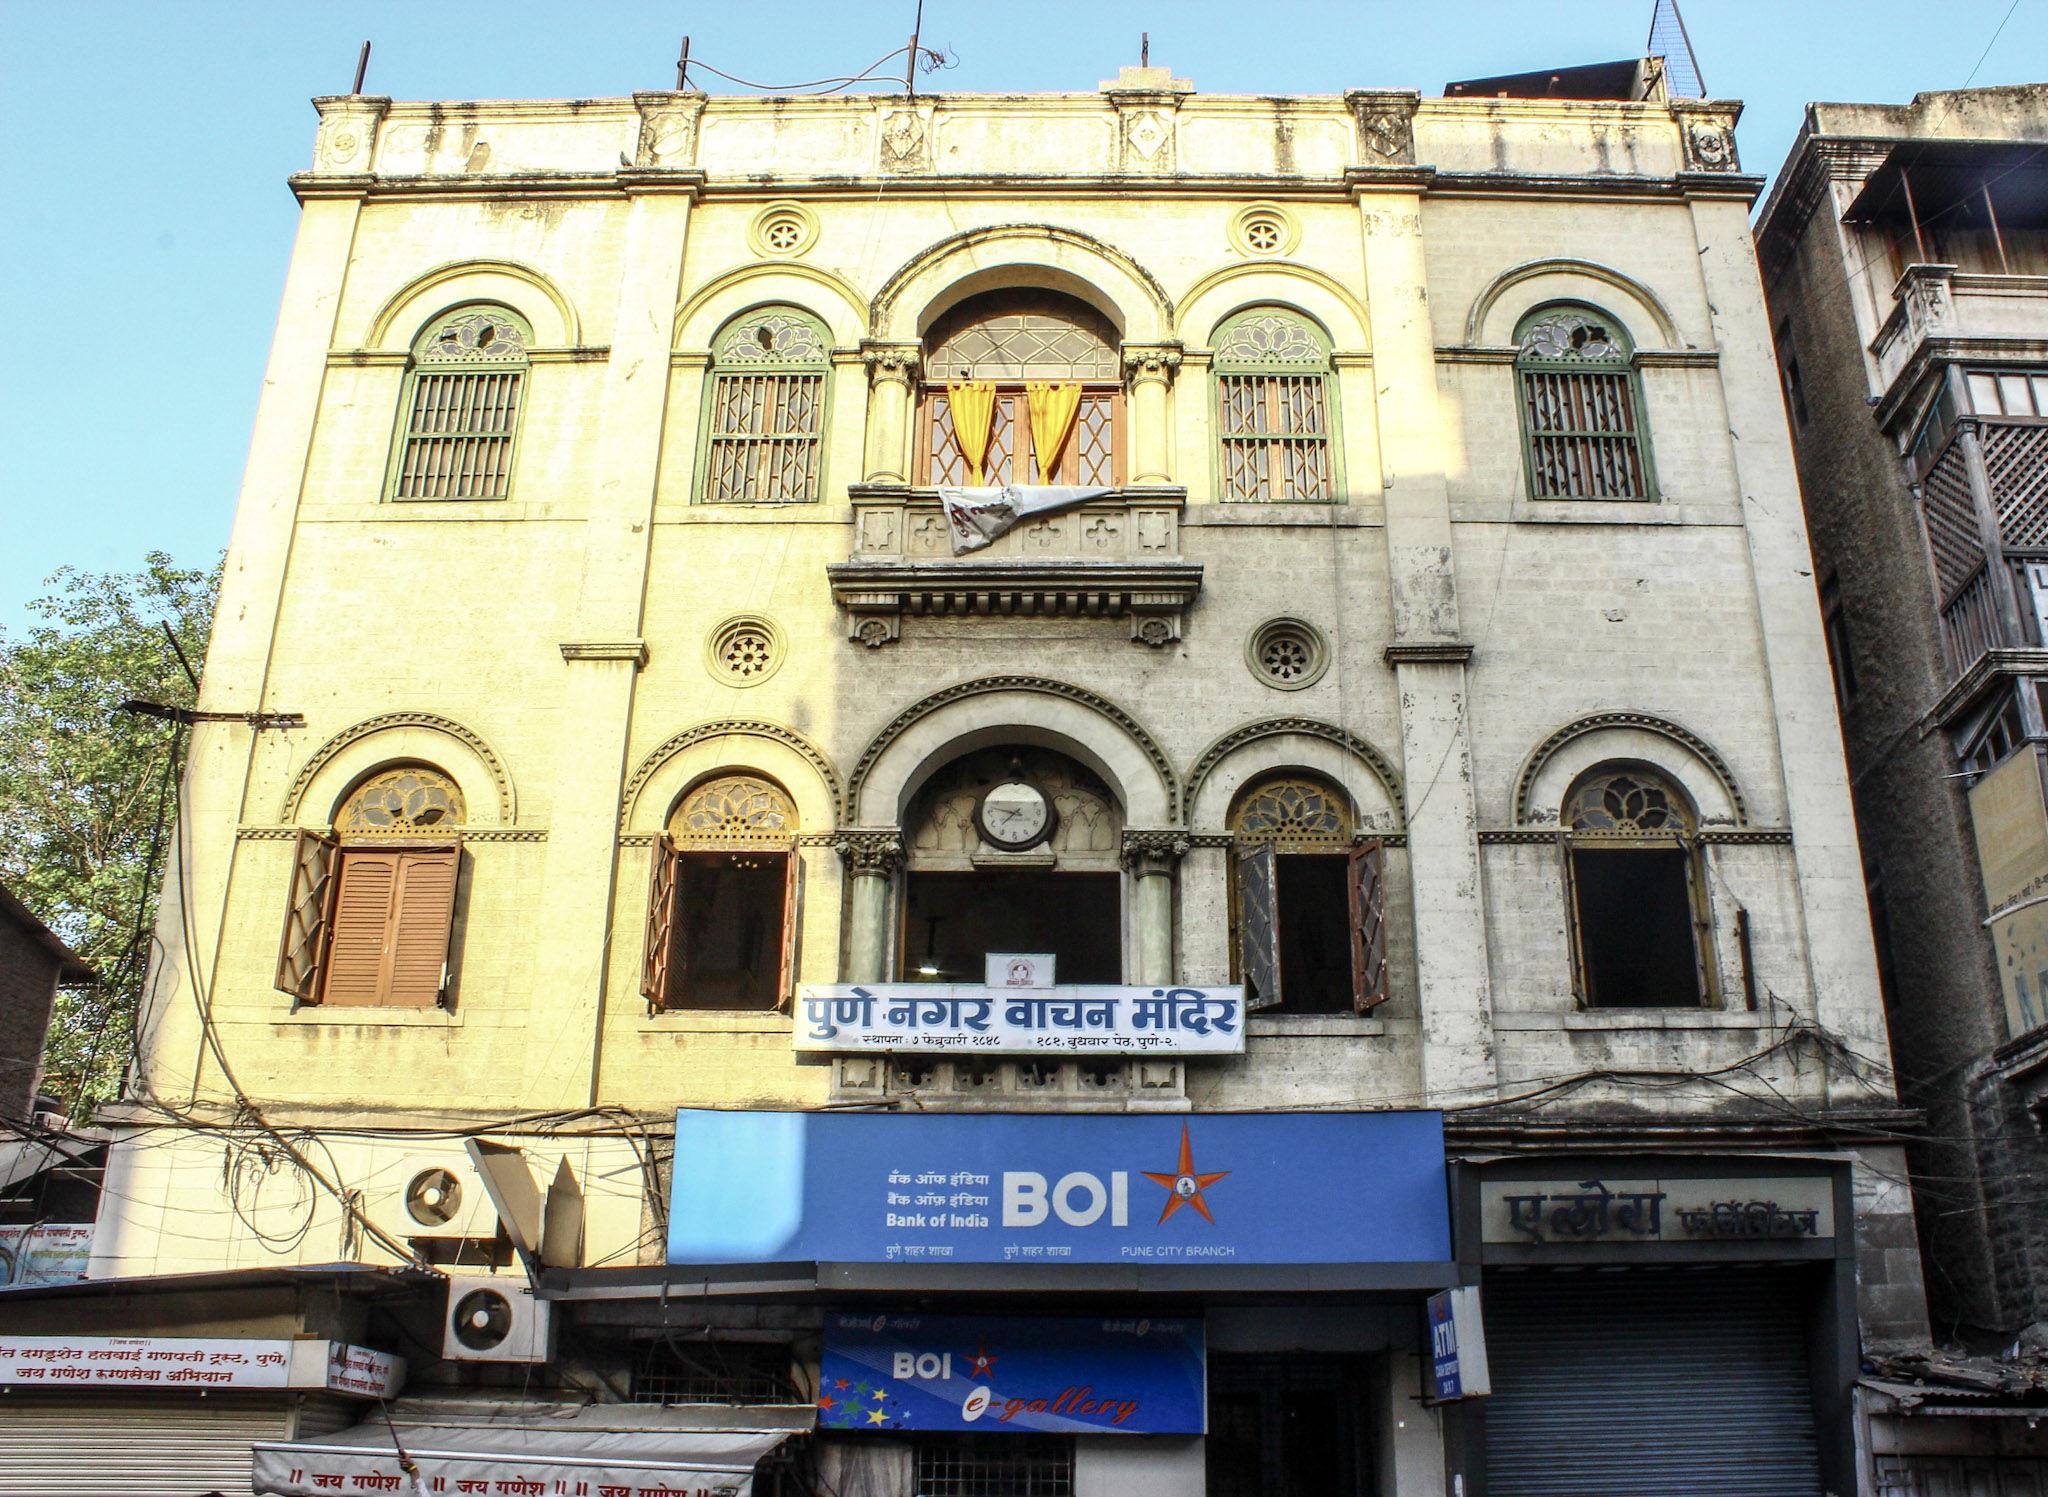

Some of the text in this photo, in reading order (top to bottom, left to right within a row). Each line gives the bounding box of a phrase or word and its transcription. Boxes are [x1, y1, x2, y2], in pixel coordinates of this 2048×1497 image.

[802, 987, 1238, 1039] पुणे नगर वाचन मंदिर
[922, 1033, 968, 1047] फेब्रुवारी
[1067, 1036, 1110, 1049] बुधवार
[1113, 1033, 1135, 1048] पेठ,
[888, 1169, 989, 1187] बँक ऑफ इंडिया
[887, 1191, 911, 1205] बैंक
[950, 1192, 989, 1208] इंडिया
[1002, 1171, 1129, 1227] BOI
[886, 1213, 989, 1228] Bank of India
[886, 1243, 954, 1259] पुणे शहर शाखा
[1003, 1243, 1071, 1259] पुणे शहर शाखा
[1121, 1246, 1235, 1257] PUNE CITY BRANCH
[1434, 1320, 1456, 1359] ATM
[21, 1347, 83, 1362] दगडूशेठ
[88, 1349, 144, 1361] हलवाई
[147, 1350, 205, 1362] गणपती
[210, 1353, 249, 1365] ट्रस्ट,
[256, 1352, 287, 1367] पुणे,
[893, 1352, 951, 1379] BOI
[16, 1368, 46, 1379] जय
[50, 1365, 92, 1380] गणेश
[166, 1368, 233, 1382] अभियान
[966, 1386, 1139, 1424] e-gallery
[312, 1474, 344, 1489] जय
[352, 1470, 402, 1492] गणेश
[456, 1479, 489, 1495] जय
[495, 1475, 546, 1497] गणेश
[598, 1484, 631, 1497] जय
